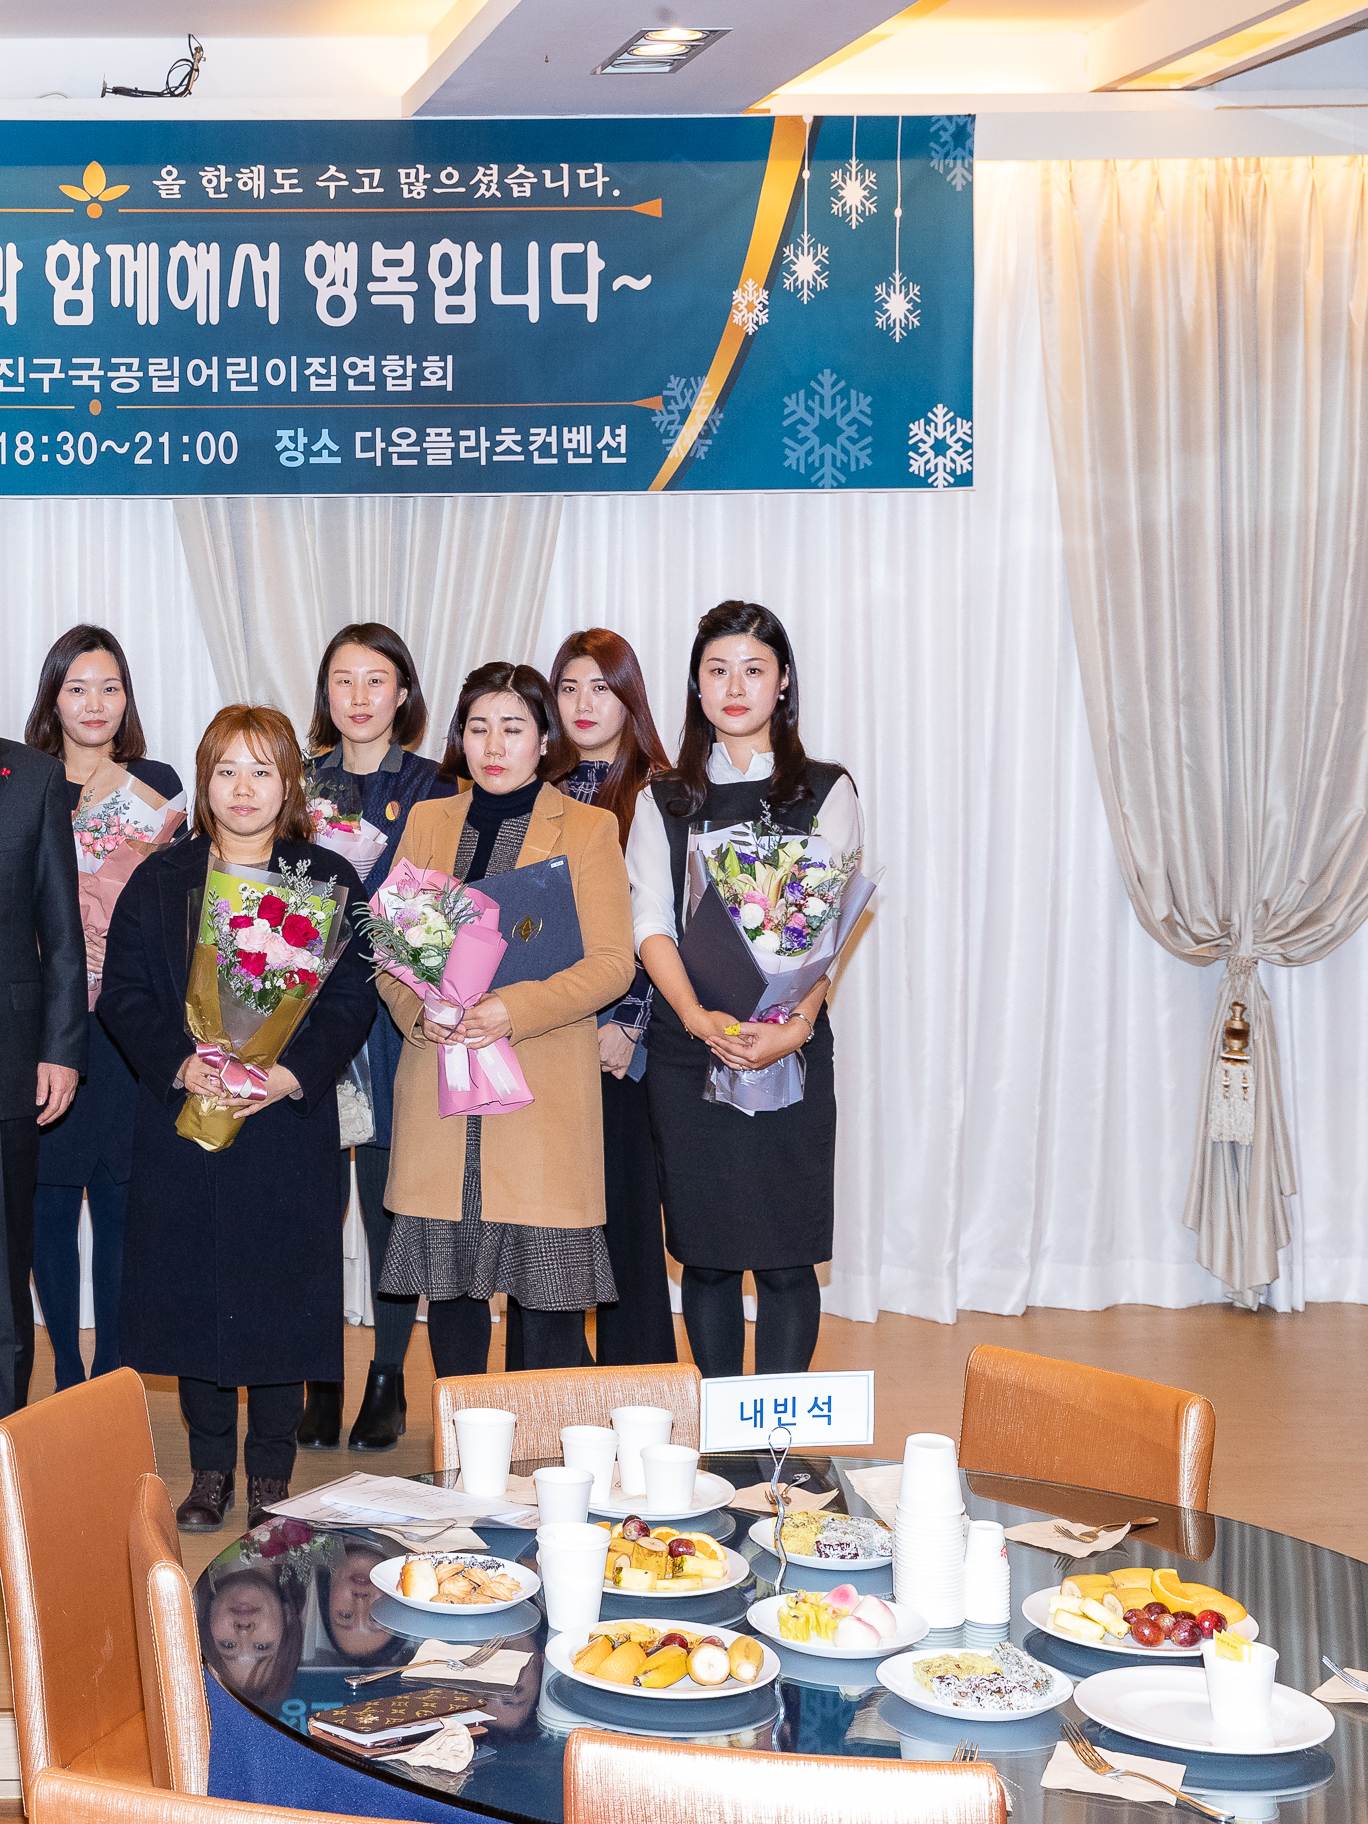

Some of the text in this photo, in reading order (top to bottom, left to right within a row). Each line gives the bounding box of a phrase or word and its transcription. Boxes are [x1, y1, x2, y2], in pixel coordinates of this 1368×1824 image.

[152, 162, 621, 200] 올 한해도 수고 많으셨습니다.
[44, 238, 280, 326] 함께해서
[304, 237, 652, 327] 행복합니다~
[274, 427, 342, 468] 장소
[355, 424, 627, 467] 다온플라츠컨벤션
[739, 1395, 832, 1429] 내빈석
